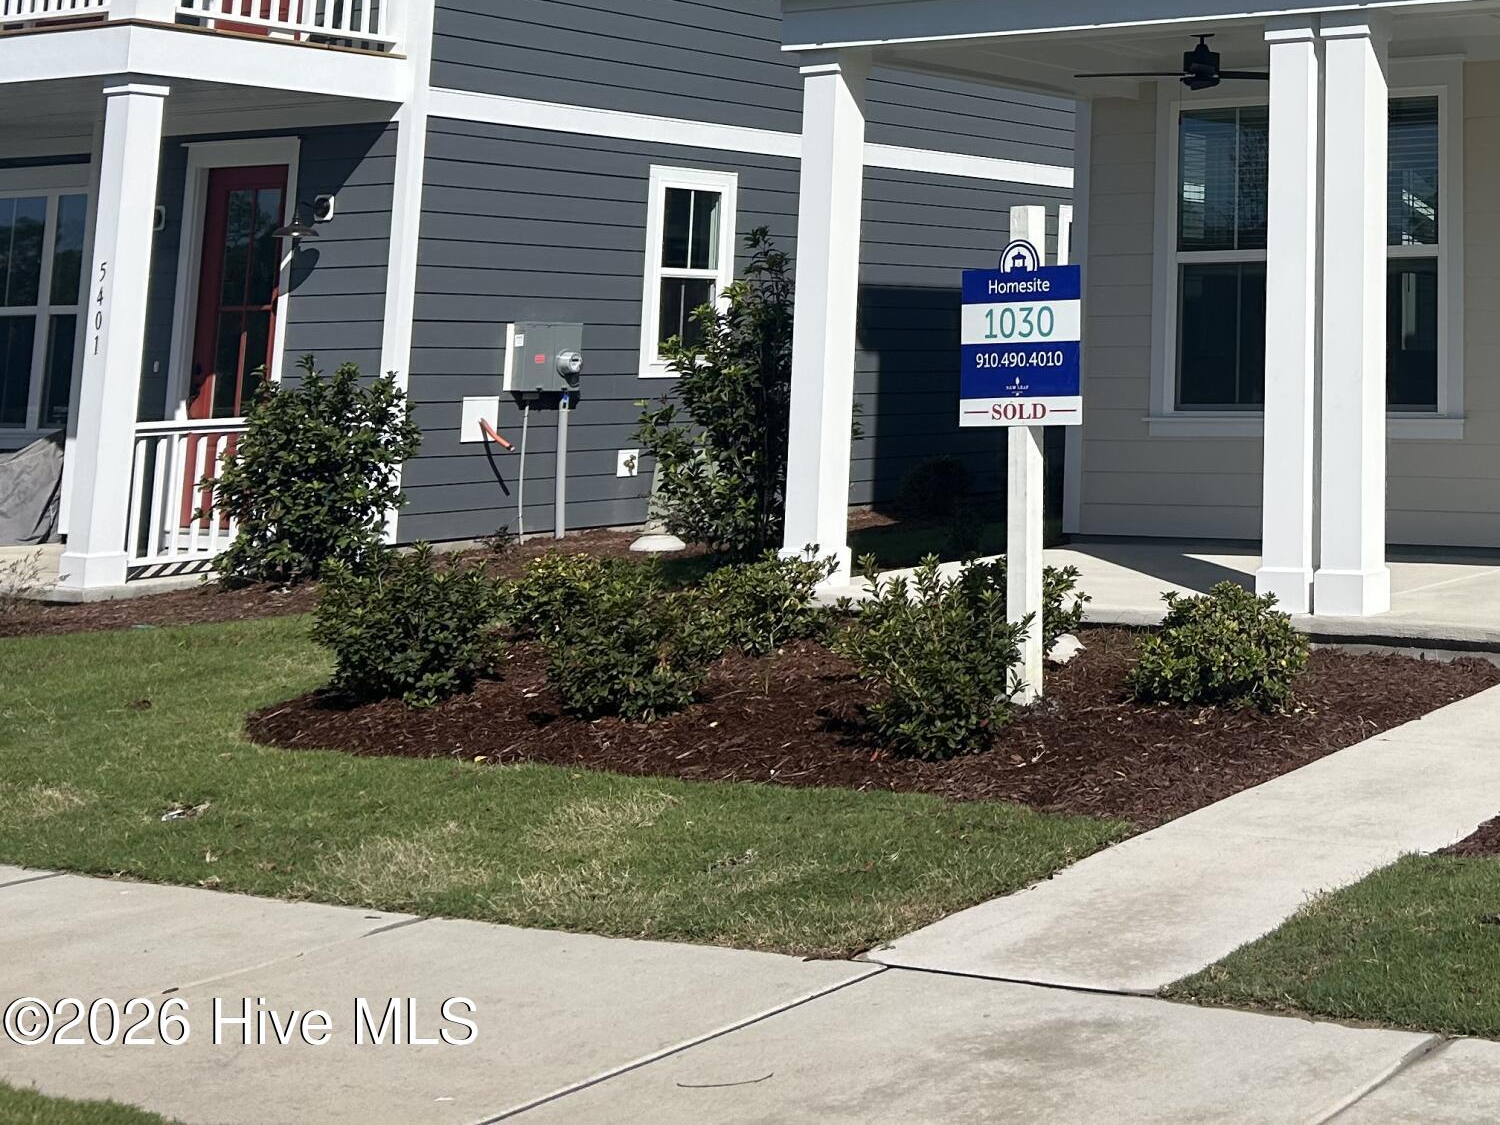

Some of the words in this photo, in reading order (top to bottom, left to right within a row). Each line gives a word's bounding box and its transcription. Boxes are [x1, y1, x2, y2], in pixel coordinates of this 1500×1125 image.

[988, 278, 1051, 295] Homesite
[93, 261, 107, 356] 5401
[984, 306, 1054, 339] 1030
[976, 351, 1063, 368] 910.490.4010
[991, 403, 1047, 420] SOLD
